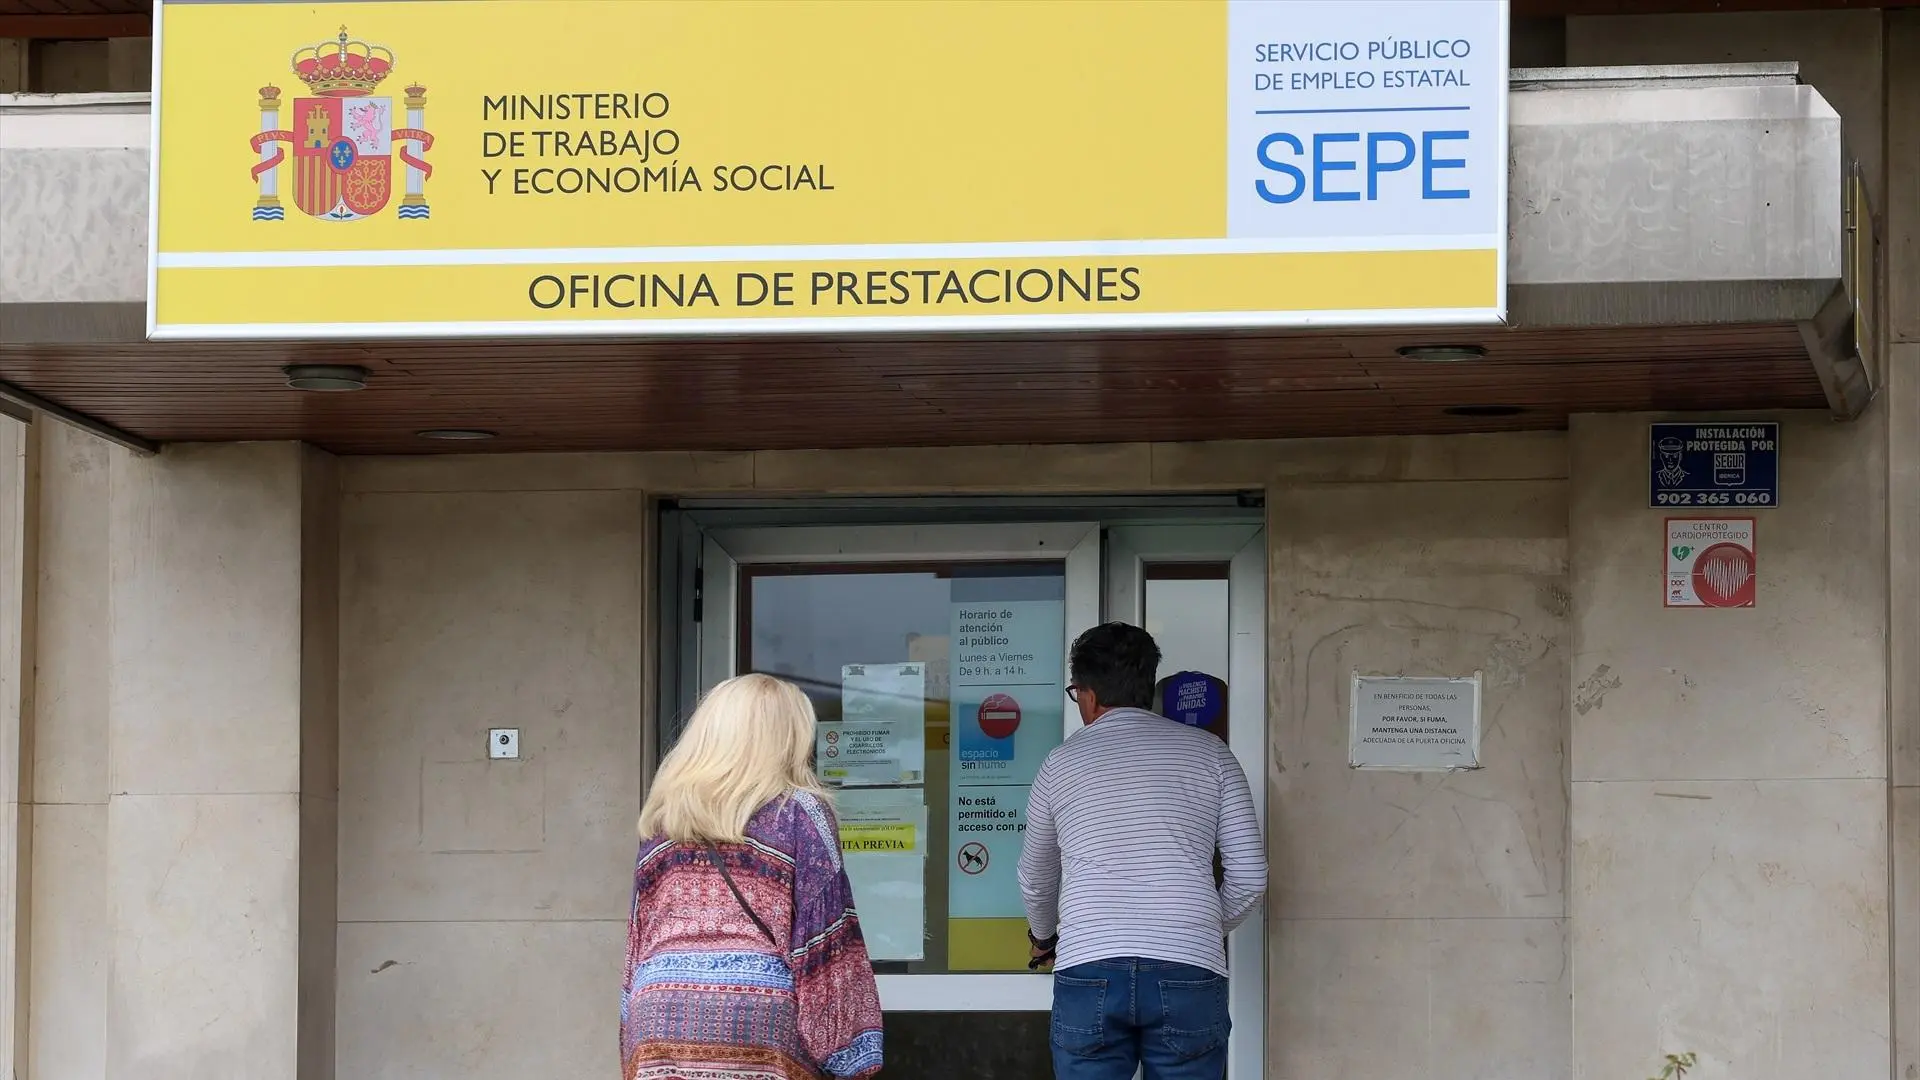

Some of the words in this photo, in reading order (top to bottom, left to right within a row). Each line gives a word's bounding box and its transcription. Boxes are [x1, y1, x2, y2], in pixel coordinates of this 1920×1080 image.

[1255, 42, 1359, 62] SERVICIO
[1368, 36, 1471, 60] PÚBLICO
[1255, 73, 1284, 91] DE
[1291, 71, 1375, 90] EMPLEO
[1383, 69, 1471, 88] ESTATAL
[483, 92, 670, 121] MINISTERIO
[483, 131, 526, 157] DE
[532, 129, 680, 163] TRABAJO
[1255, 130, 1471, 204] SEPE
[481, 169, 502, 194] Y
[513, 160, 702, 194] ECONOMÍA
[713, 164, 835, 192] SOCIAL
[528, 273, 720, 309] OFICINA
[736, 272, 794, 306] DE
[811, 267, 1141, 305] PRESTACIONES
[1695, 426, 1765, 439] INSTALACIÓN
[1686, 440, 1746, 451] PROTEGIDA
[1751, 440, 1774, 451] POR
[1715, 454, 1745, 468] SEGUR
[1657, 493, 1692, 504] 902
[1697, 493, 1730, 504] 365
[1735, 493, 1771, 504] 060
[1692, 523, 1729, 531] CENTRO
[1671, 531, 1749, 540] CARDIOPROTEGIDO
[959, 610, 997, 620] Horario
[1000, 609, 1013, 619] de
[959, 622, 1003, 633] atención
[959, 636, 968, 646] al
[971, 635, 1009, 648] público
[959, 653, 988, 662] Lunes
[999, 653, 1034, 661] Viernes
[959, 667, 973, 676] De
[975, 667, 981, 675] 9
[983, 667, 992, 676] h.
[1004, 666, 1015, 675] 14
[1018, 666, 1027, 675] h.
[1176, 698, 1207, 711] UNIDAS
[961, 747, 999, 760] espacio
[961, 760, 976, 770] sin
[978, 760, 1007, 769] humo
[958, 796, 972, 806] No
[975, 796, 996, 806] está
[958, 809, 1006, 821] permitido
[1008, 809, 1017, 818] el
[958, 823, 994, 832] acceso
[996, 822, 1014, 832] con
[841, 840, 861, 850] ITA
[863, 840, 905, 849] PREVIA
